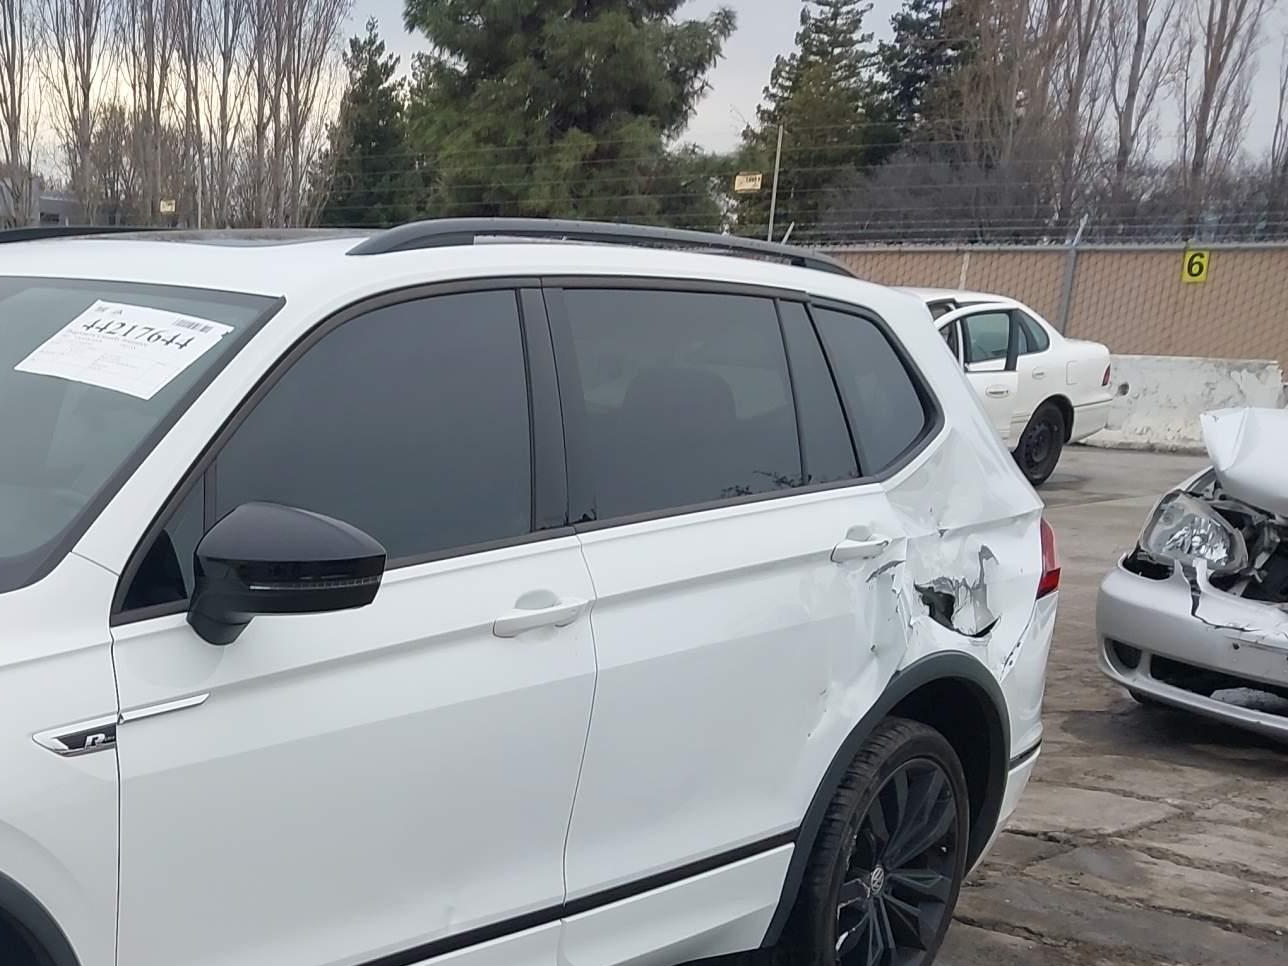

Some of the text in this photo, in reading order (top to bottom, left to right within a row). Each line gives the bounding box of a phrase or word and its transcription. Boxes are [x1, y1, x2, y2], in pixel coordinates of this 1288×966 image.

[1187, 252, 1205, 277] 6
[82, 319, 195, 350] 44217644
[85, 733, 107, 750] R
